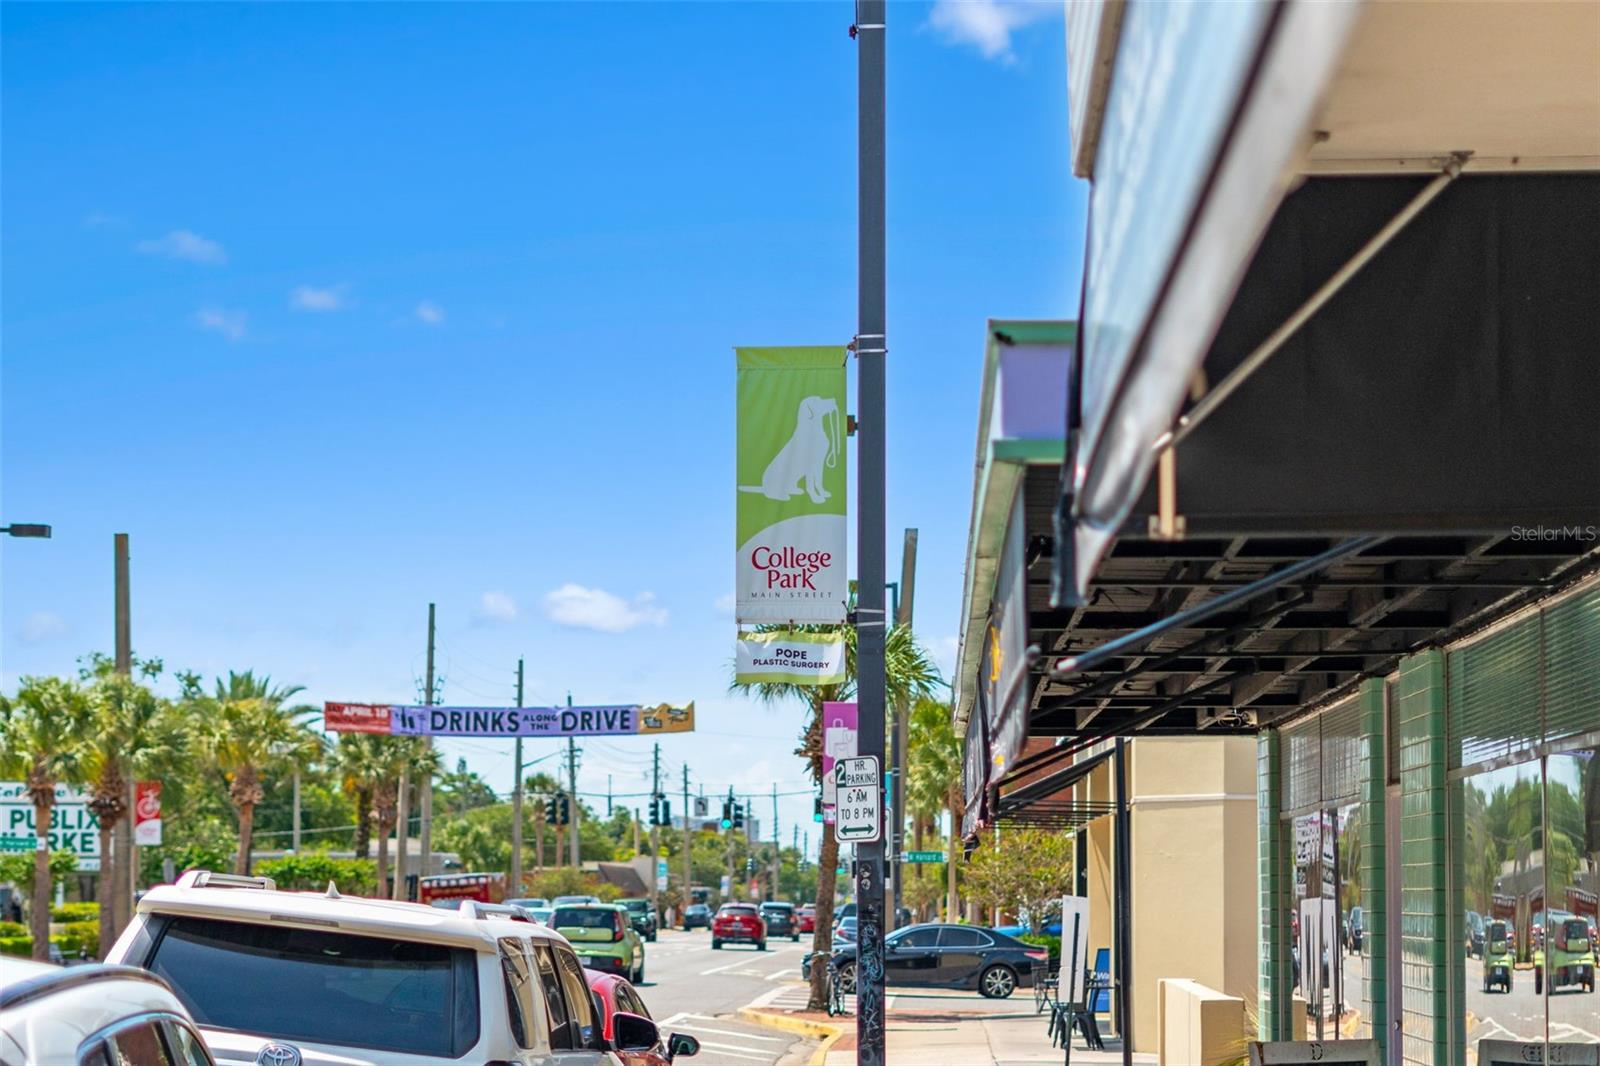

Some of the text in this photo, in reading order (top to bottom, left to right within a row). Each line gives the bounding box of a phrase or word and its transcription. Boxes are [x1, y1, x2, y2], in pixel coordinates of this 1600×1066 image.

[751, 546, 832, 573] College
[767, 568, 817, 591] Park
[776, 648, 807, 660] POPE
[791, 659, 829, 669] SURGERY
[343, 705, 374, 718] APRIL
[523, 714, 558, 722] ALONG
[430, 711, 520, 732] DRINKS
[561, 709, 631, 732] DRIVE
[836, 763, 846, 785] 2
[847, 773, 876, 785] PARKING
[847, 791, 867, 803] 6 AM
[10, 809, 101, 829] PUBLIX
[841, 808, 851, 820] TO
[854, 808, 860, 819] 8
[863, 807, 874, 818] PM
[2, 833, 102, 853] RKE
